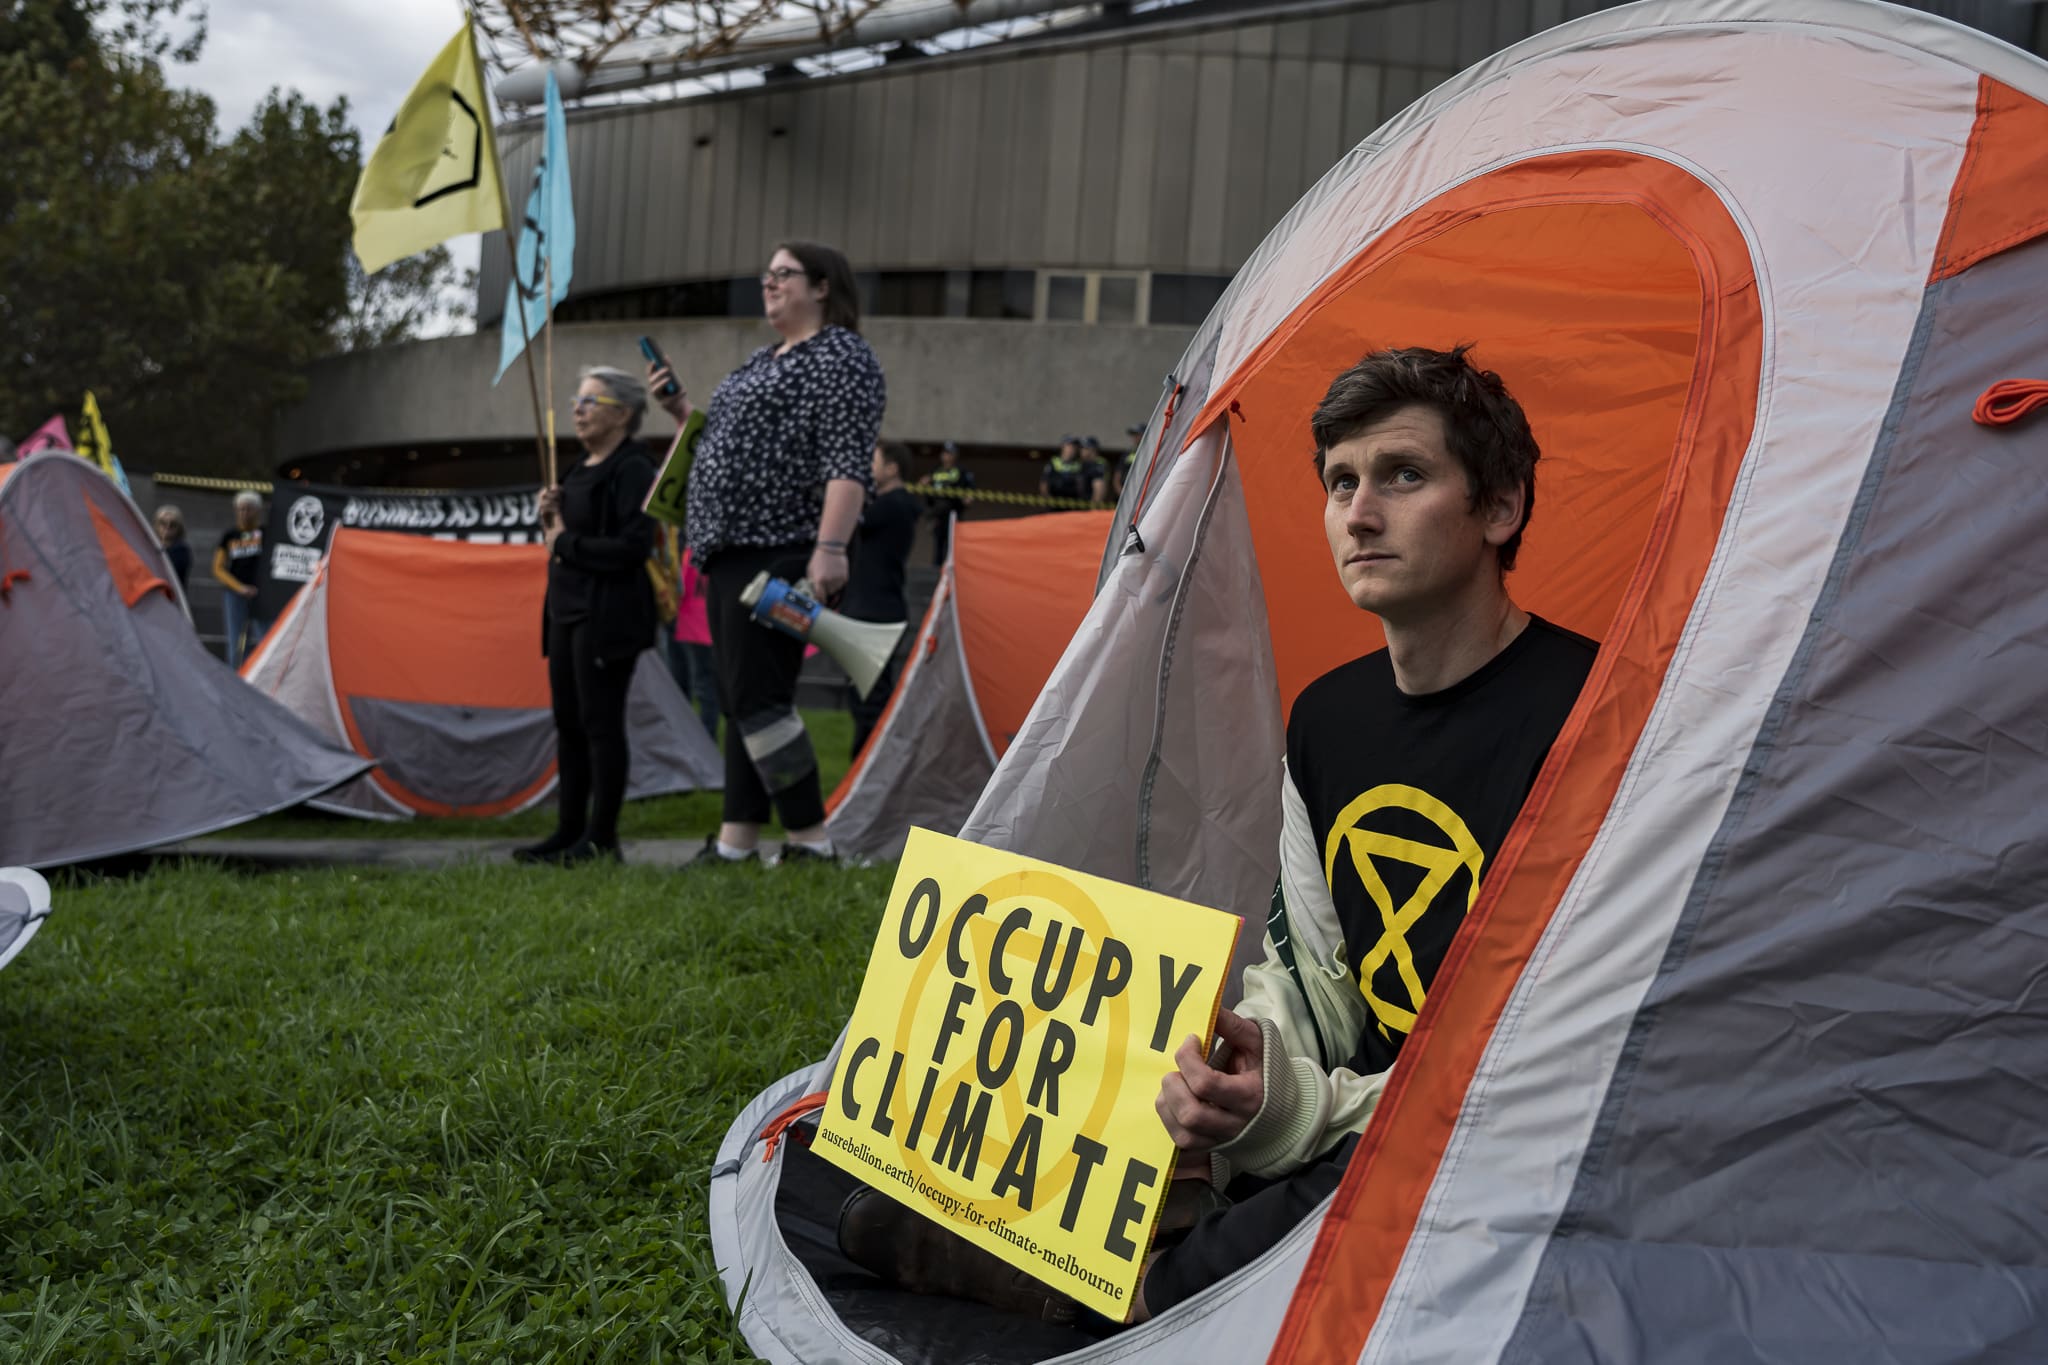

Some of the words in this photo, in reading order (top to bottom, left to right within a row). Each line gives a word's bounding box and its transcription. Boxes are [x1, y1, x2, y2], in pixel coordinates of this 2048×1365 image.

[342, 495, 445, 528] BUSINESS
[445, 495, 480, 528] AS
[899, 877, 1202, 1053] OCCUPY
[932, 981, 1077, 1117] FOR
[822, 1126, 1123, 1300] ausrebellion.earth/occupy-for-climate-melbourne
[841, 1037, 1158, 1262] CLIMATE
